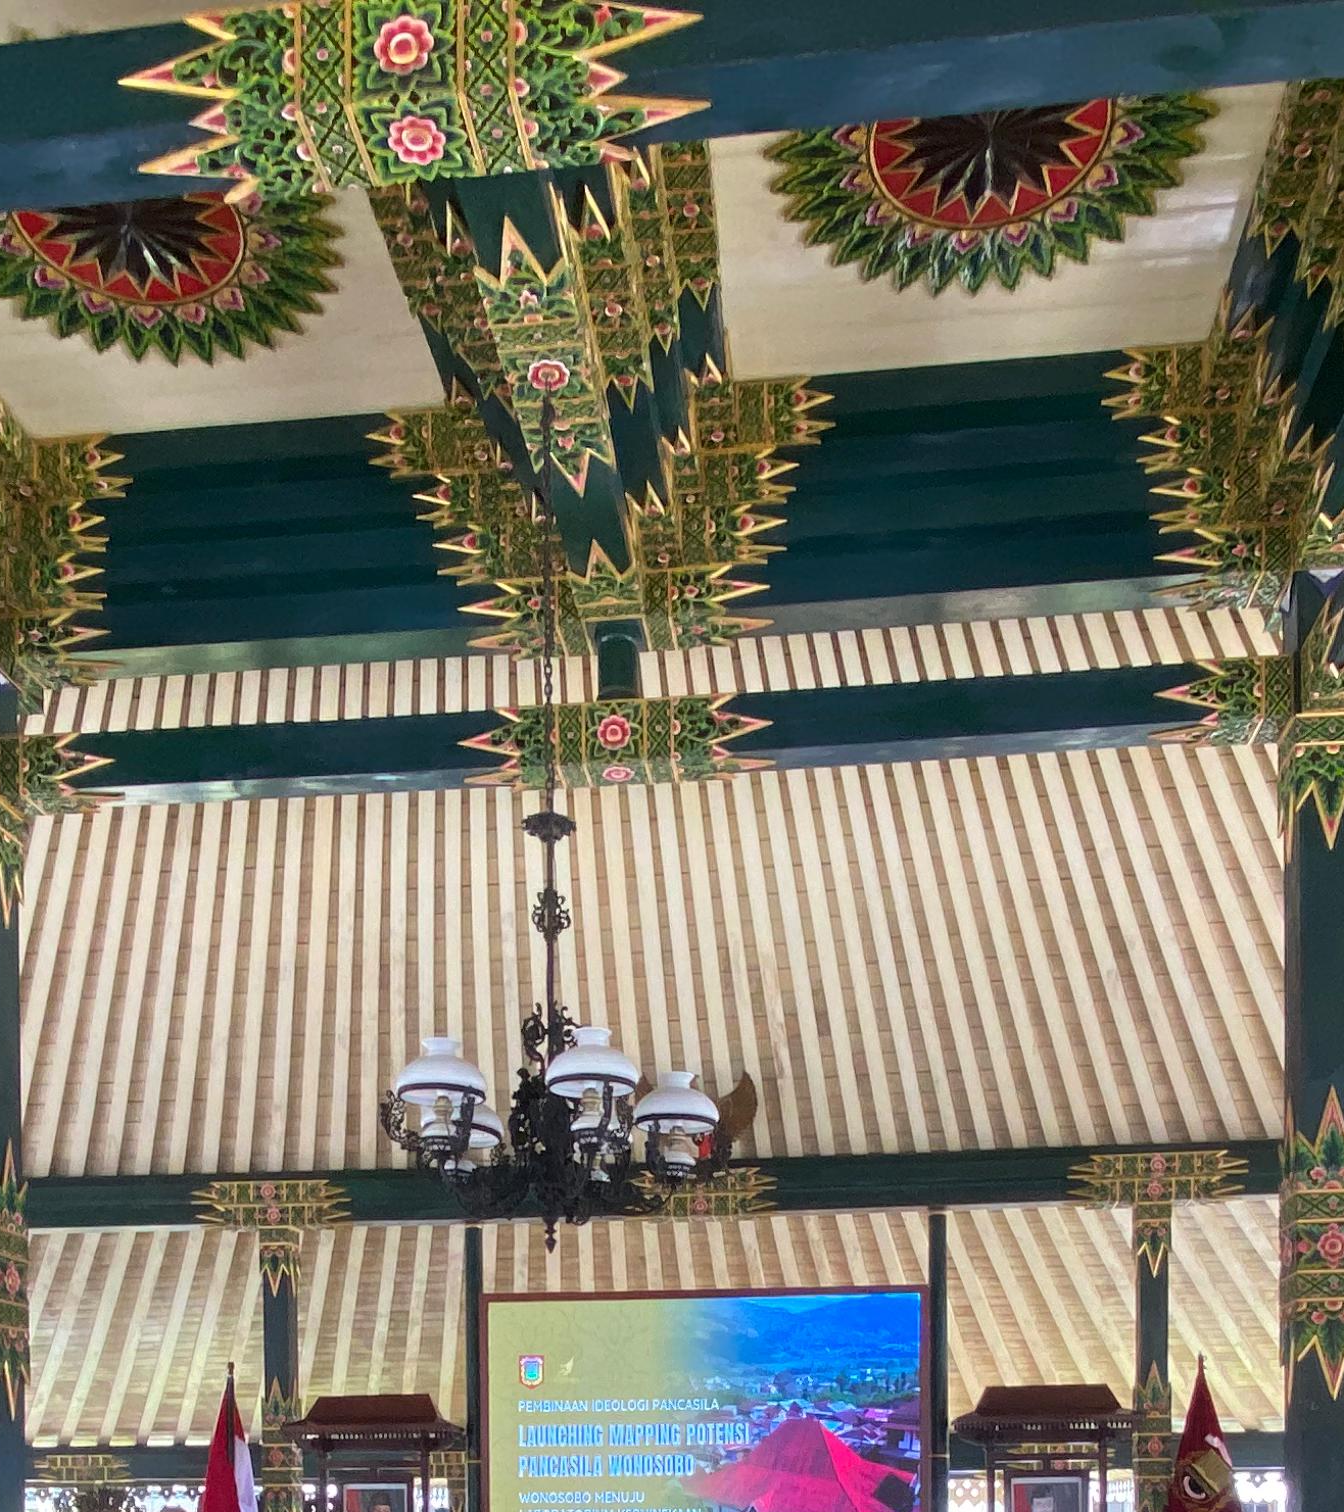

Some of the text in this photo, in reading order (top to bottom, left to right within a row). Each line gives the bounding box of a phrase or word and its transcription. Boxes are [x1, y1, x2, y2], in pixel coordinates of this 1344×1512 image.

[518, 1398, 720, 1413] PEMBINAAN IDEOLOGI PANCASILA
[518, 1422, 750, 1447] LAUNCHING MAPPING POTENSI
[518, 1454, 695, 1478] PANCASILA WONOSOBO
[519, 1491, 645, 1504] WONOSOBO MENUJU
